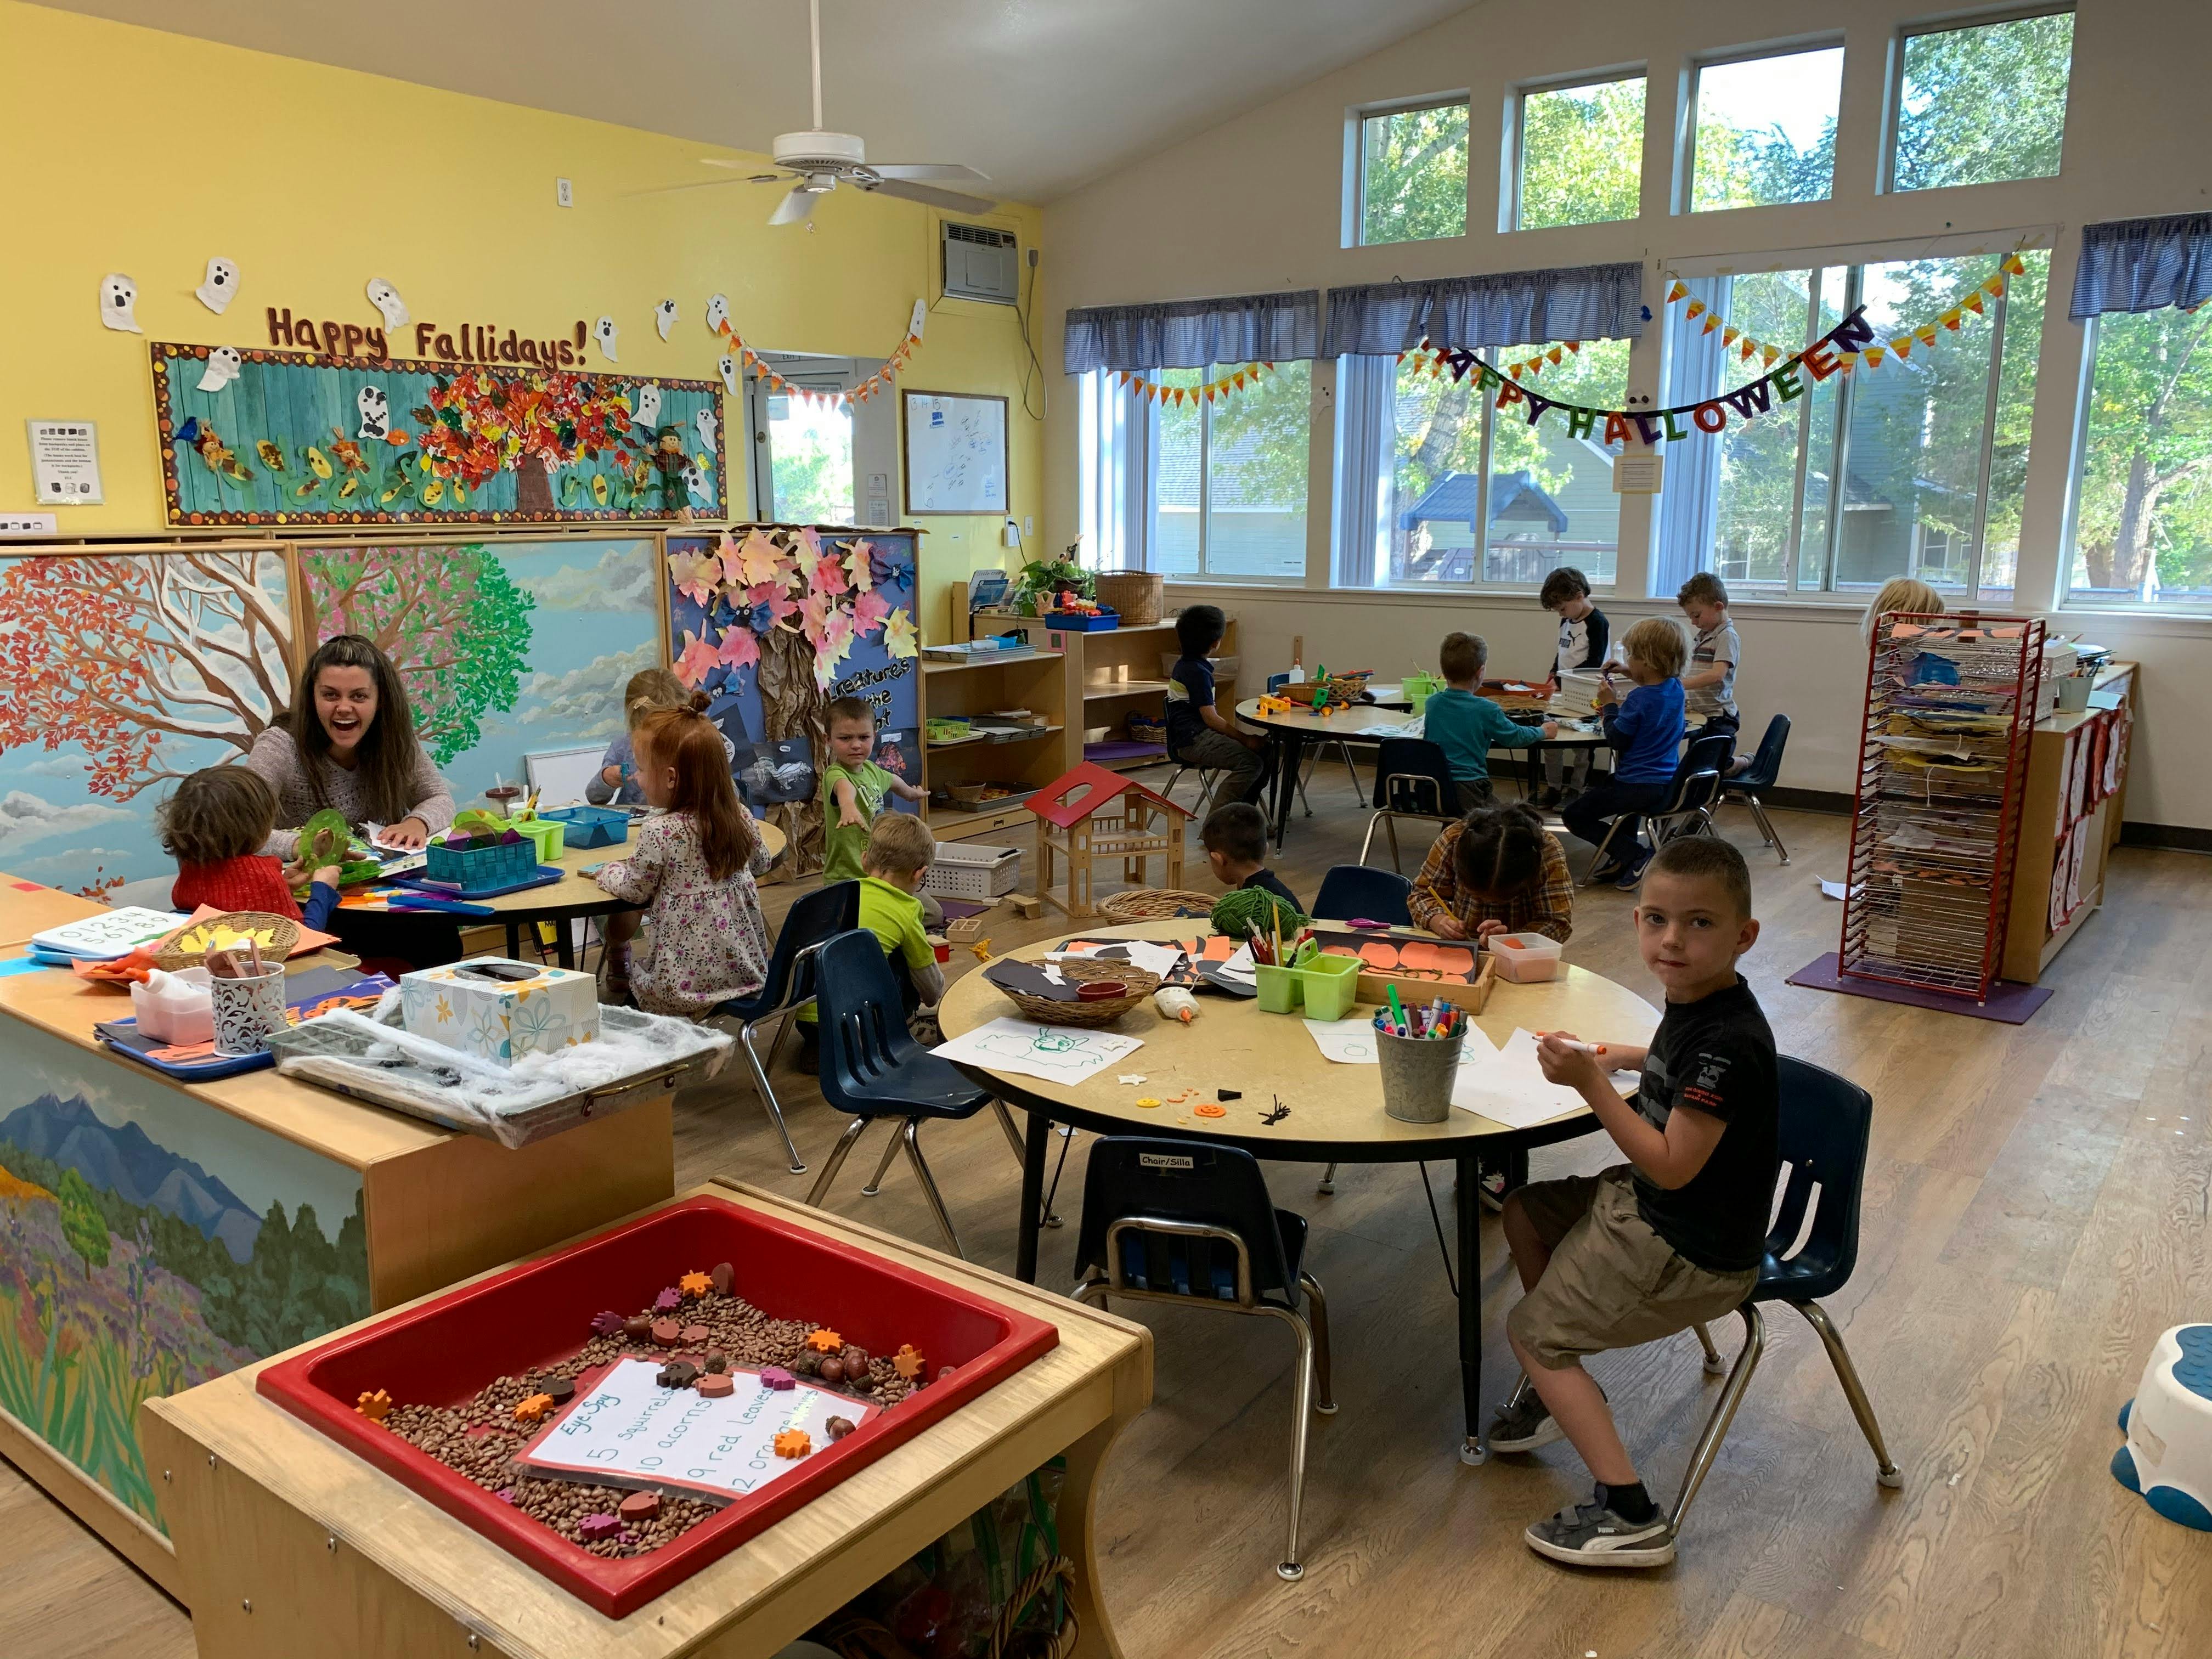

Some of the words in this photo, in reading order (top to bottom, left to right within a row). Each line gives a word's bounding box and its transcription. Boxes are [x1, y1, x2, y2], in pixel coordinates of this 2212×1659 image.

[267, 308, 389, 365] Happy
[416, 320, 587, 375] Fallidays!
[1567, 304, 1875, 445] HALLOWEEN
[932, 397, 941, 410] 15
[1142, 1156, 1190, 1166] Chair/Silla
[586, 1448, 619, 1462] 5
[618, 1389, 675, 1441] squirrels
[636, 1457, 663, 1471] 10
[657, 1400, 713, 1448] acorns
[687, 1468, 717, 1479] 9
[709, 1435, 742, 1461] red
[727, 1478, 757, 1492] 12
